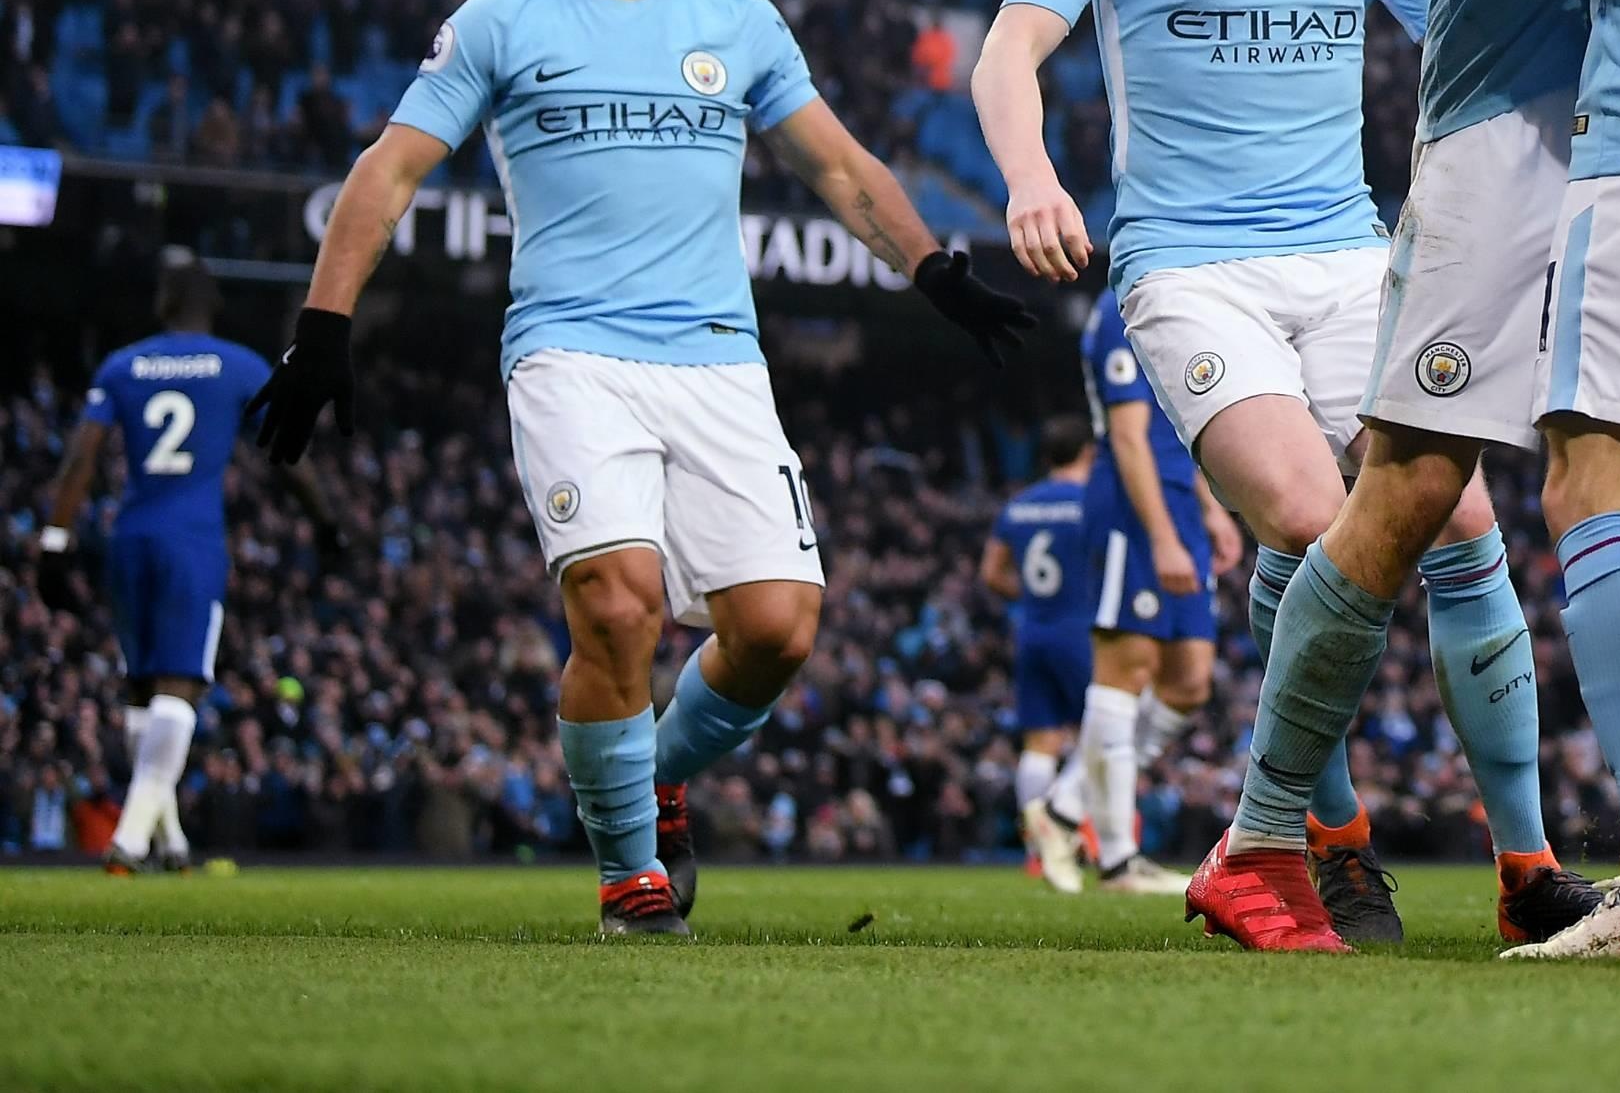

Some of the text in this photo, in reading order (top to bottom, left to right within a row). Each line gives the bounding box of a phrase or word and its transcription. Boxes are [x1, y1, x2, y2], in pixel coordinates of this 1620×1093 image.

[1166, 10, 1357, 41] ETIHAD
[1210, 45, 1334, 64] AIRWAYS
[536, 102, 726, 134] ETIHAD
[572, 128, 698, 143] AIRWAYS
[1425, 346, 1467, 367] MANCHESTER
[142, 389, 196, 475] 2
[1022, 528, 1064, 599] 6
[1489, 671, 1532, 703] CITY
